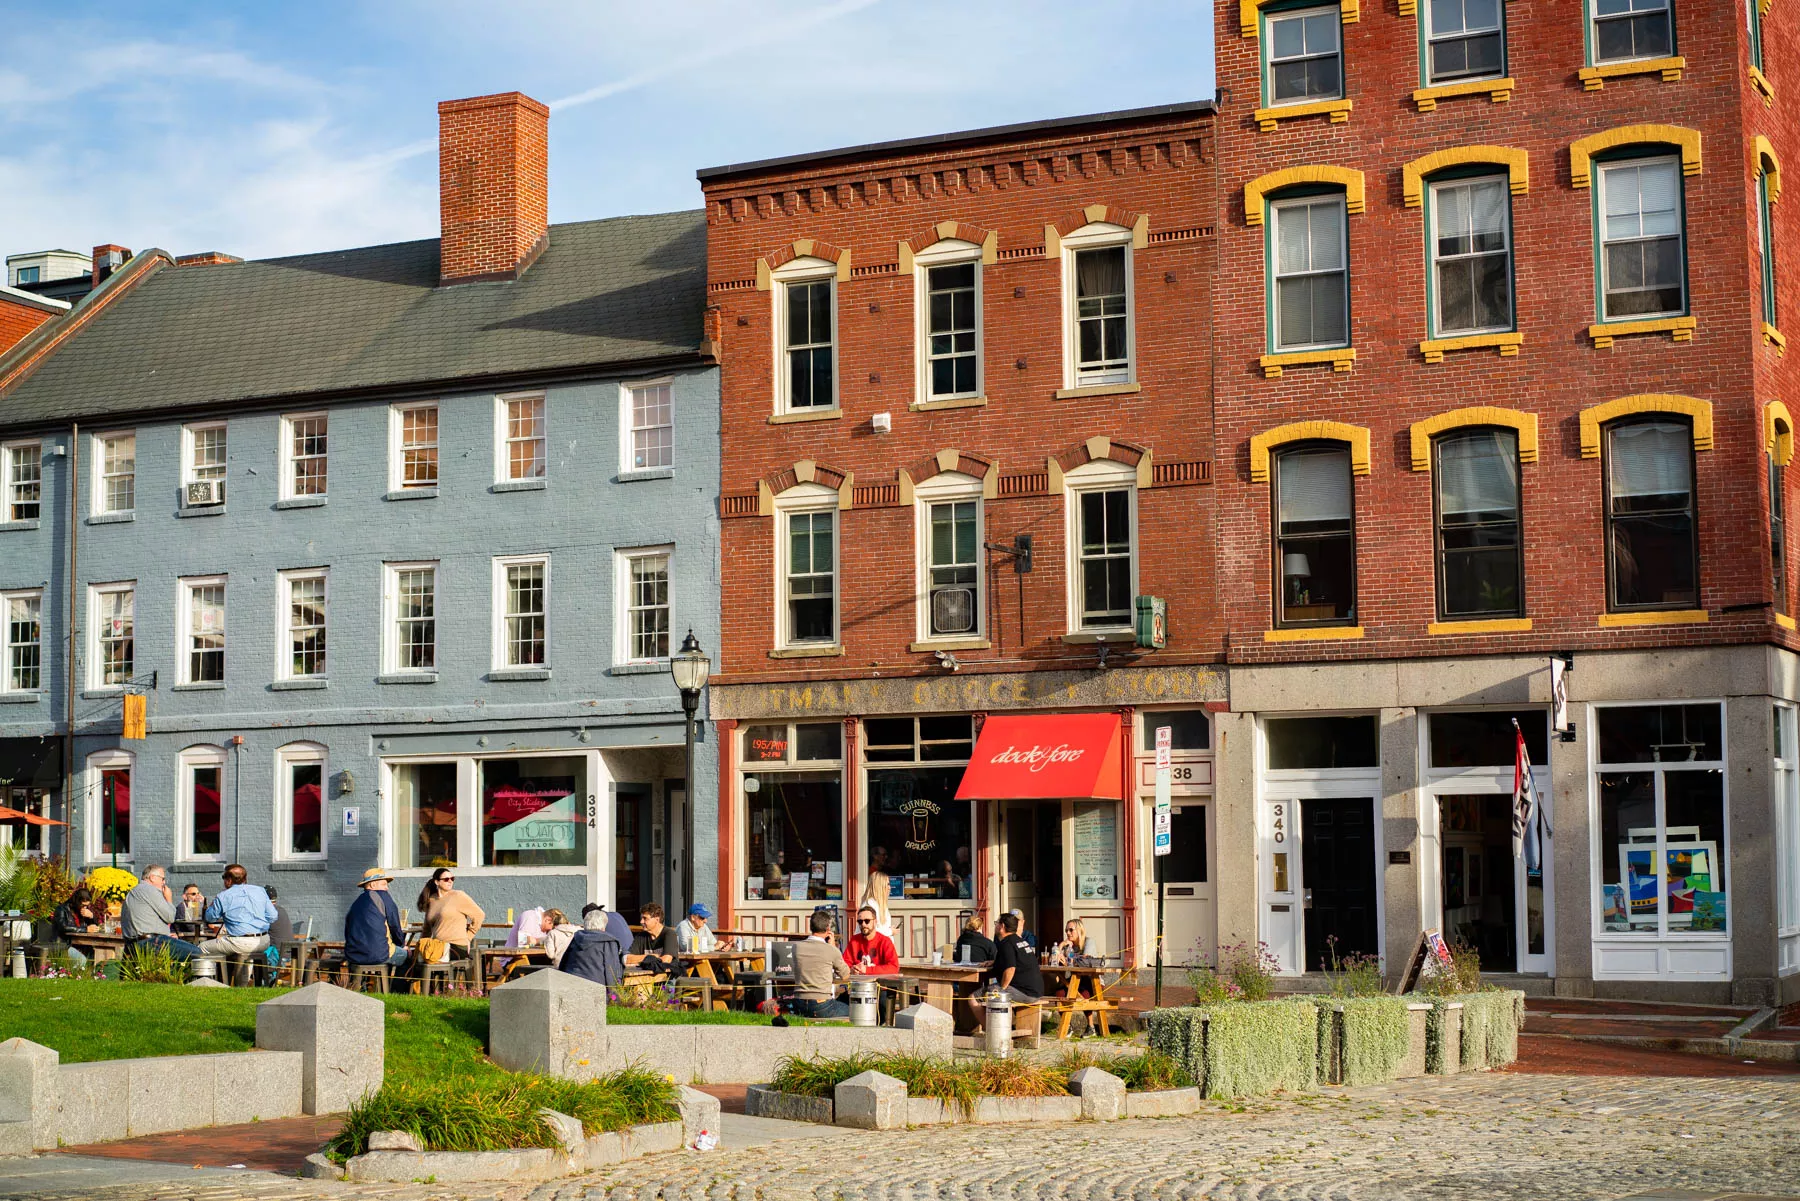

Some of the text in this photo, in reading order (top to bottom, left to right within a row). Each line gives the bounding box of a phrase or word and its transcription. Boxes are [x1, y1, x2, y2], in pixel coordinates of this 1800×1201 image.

[1169, 767, 1193, 780] 38
[588, 794, 597, 829] 334
[899, 799, 941, 815] GUINNESS
[1273, 804, 1285, 844] 340
[904, 839, 936, 851] DRAUGHT
